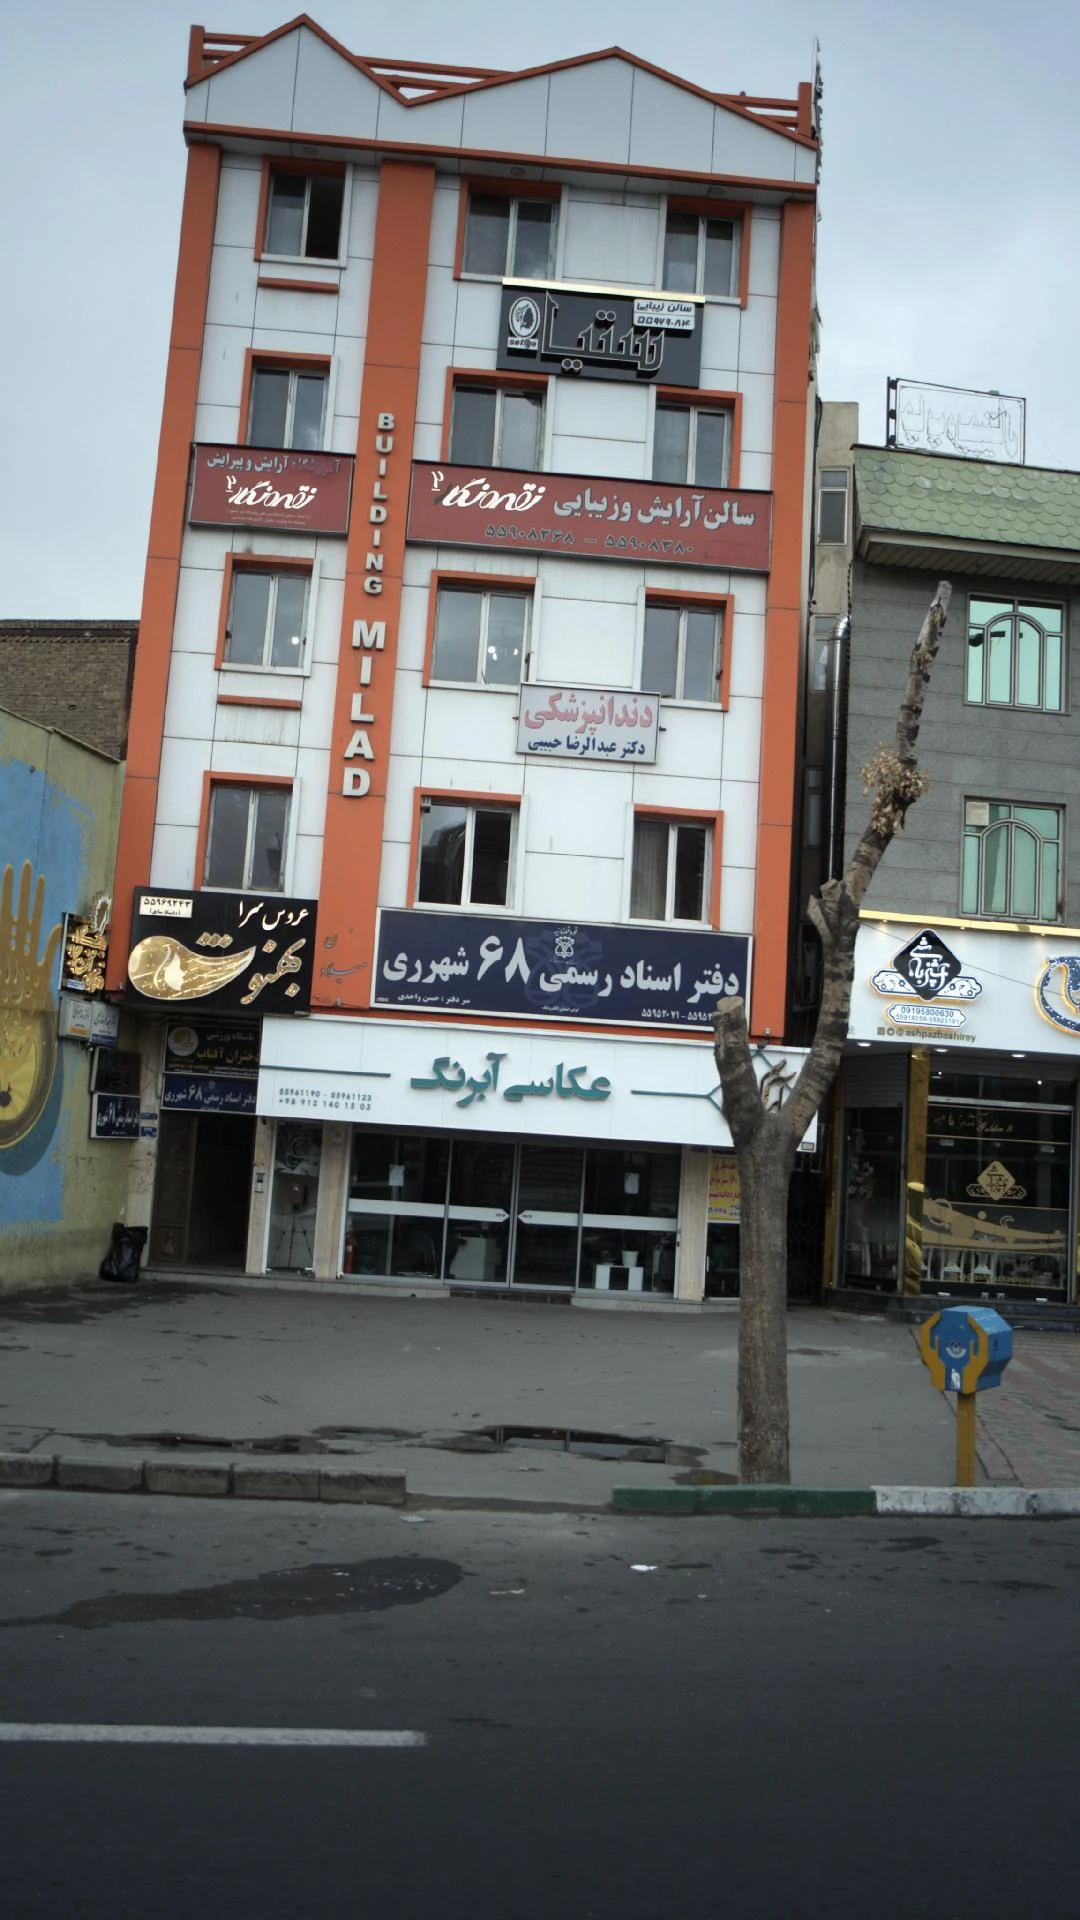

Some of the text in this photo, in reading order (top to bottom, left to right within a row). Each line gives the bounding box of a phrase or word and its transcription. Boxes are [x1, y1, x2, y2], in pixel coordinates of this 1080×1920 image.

[636, 301, 692, 313] سالن زیبایی
[207, 451, 245, 472] پیرایش
[254, 455, 290, 474] آرایش
[364, 411, 396, 596] BUILDING
[637, 494, 704, 528] آرایش
[703, 500, 755, 531] سالن
[341, 619, 387, 798] MILAD
[523, 691, 653, 735] دندانپزشکی
[528, 735, 646, 758] دکتر عبدالرضا حبیبی
[238, 900, 309, 931] عروس سرا
[382, 935, 740, 1003] دفتر اسناد رسمی ۶۸ شهرری
[410, 1052, 508, 1108] آبرنگ
